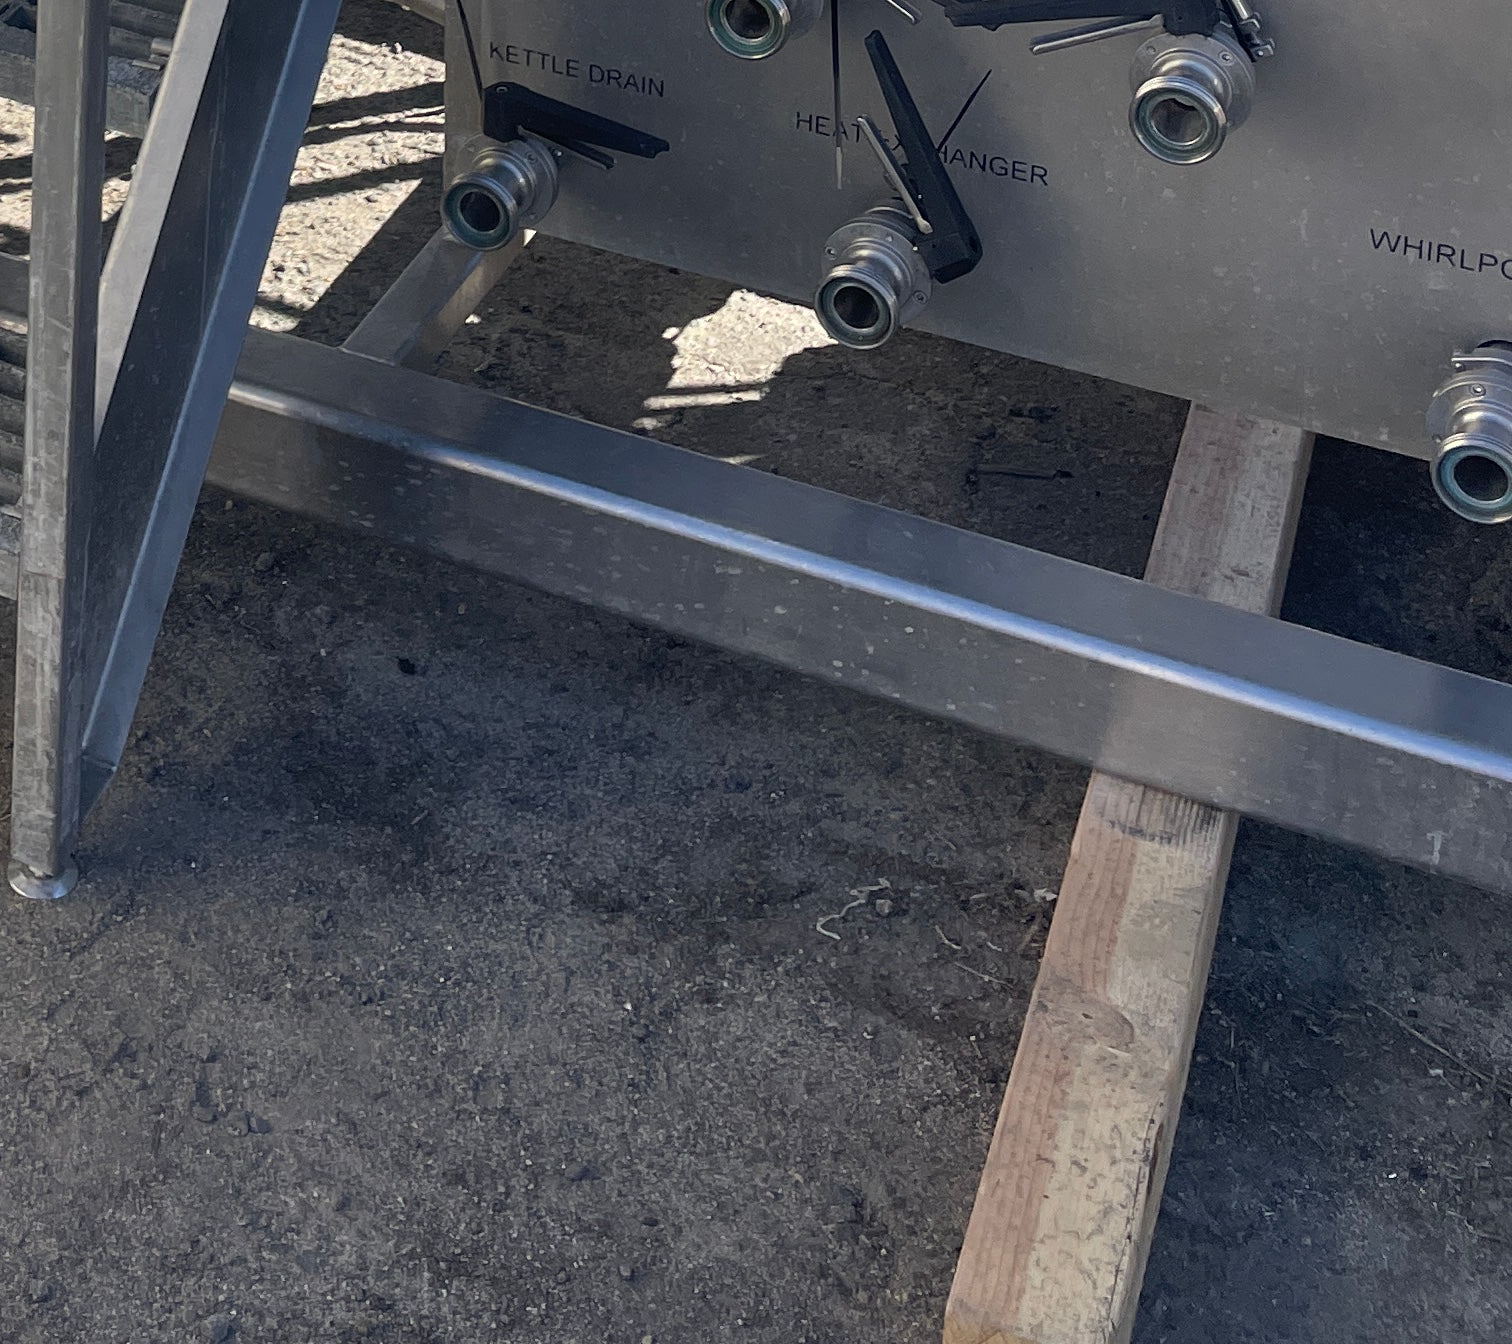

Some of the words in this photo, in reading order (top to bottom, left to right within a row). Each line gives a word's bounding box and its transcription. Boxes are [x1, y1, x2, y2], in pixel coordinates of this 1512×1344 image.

[490, 42, 580, 77] KETTLE
[589, 64, 664, 97] DRAIN
[1370, 228, 1512, 280] WHIRLPO
